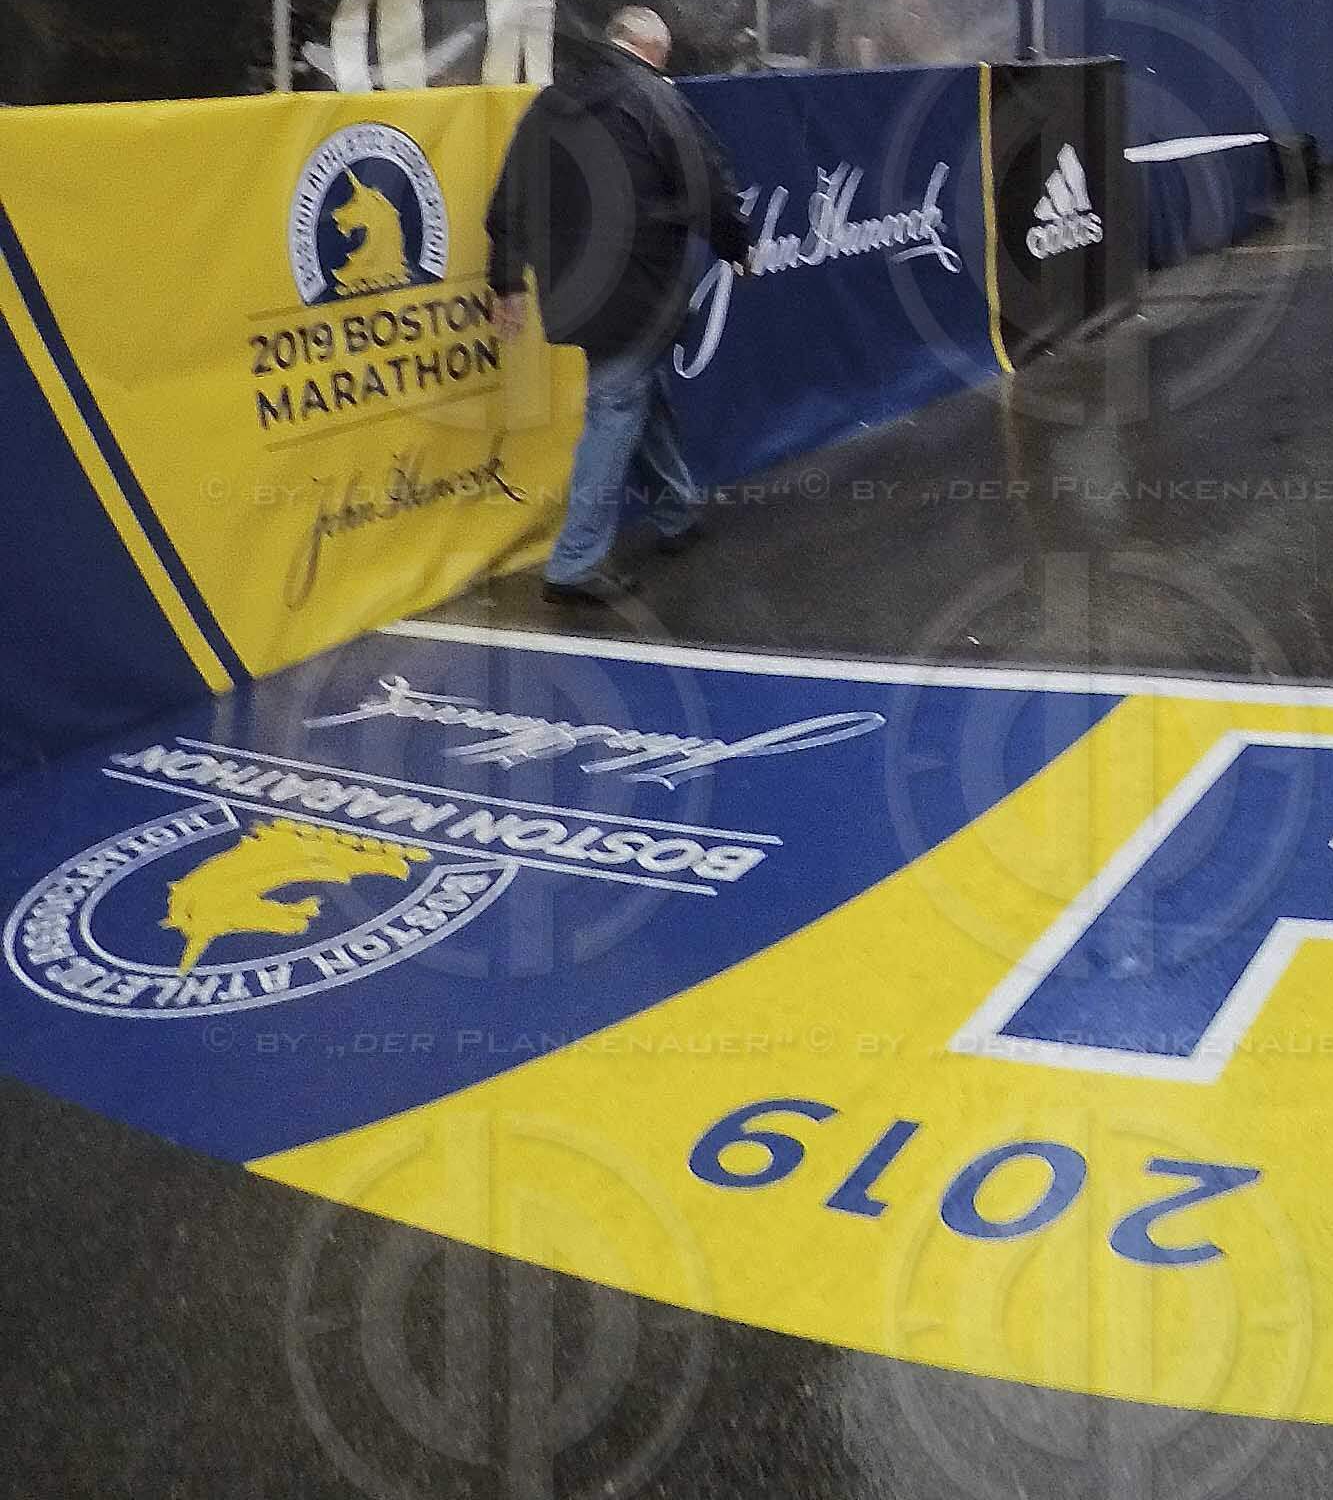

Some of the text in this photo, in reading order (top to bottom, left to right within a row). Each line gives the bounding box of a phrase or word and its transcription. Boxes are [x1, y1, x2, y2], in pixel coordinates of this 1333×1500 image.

[249, 283, 500, 377] 2019 BOSTON
[255, 334, 502, 431] MARATHON
[108, 741, 767, 885] BOSTON MARATHON
[319, 872, 493, 980] BOSTON
[687, 1095, 1262, 1269] 2019
